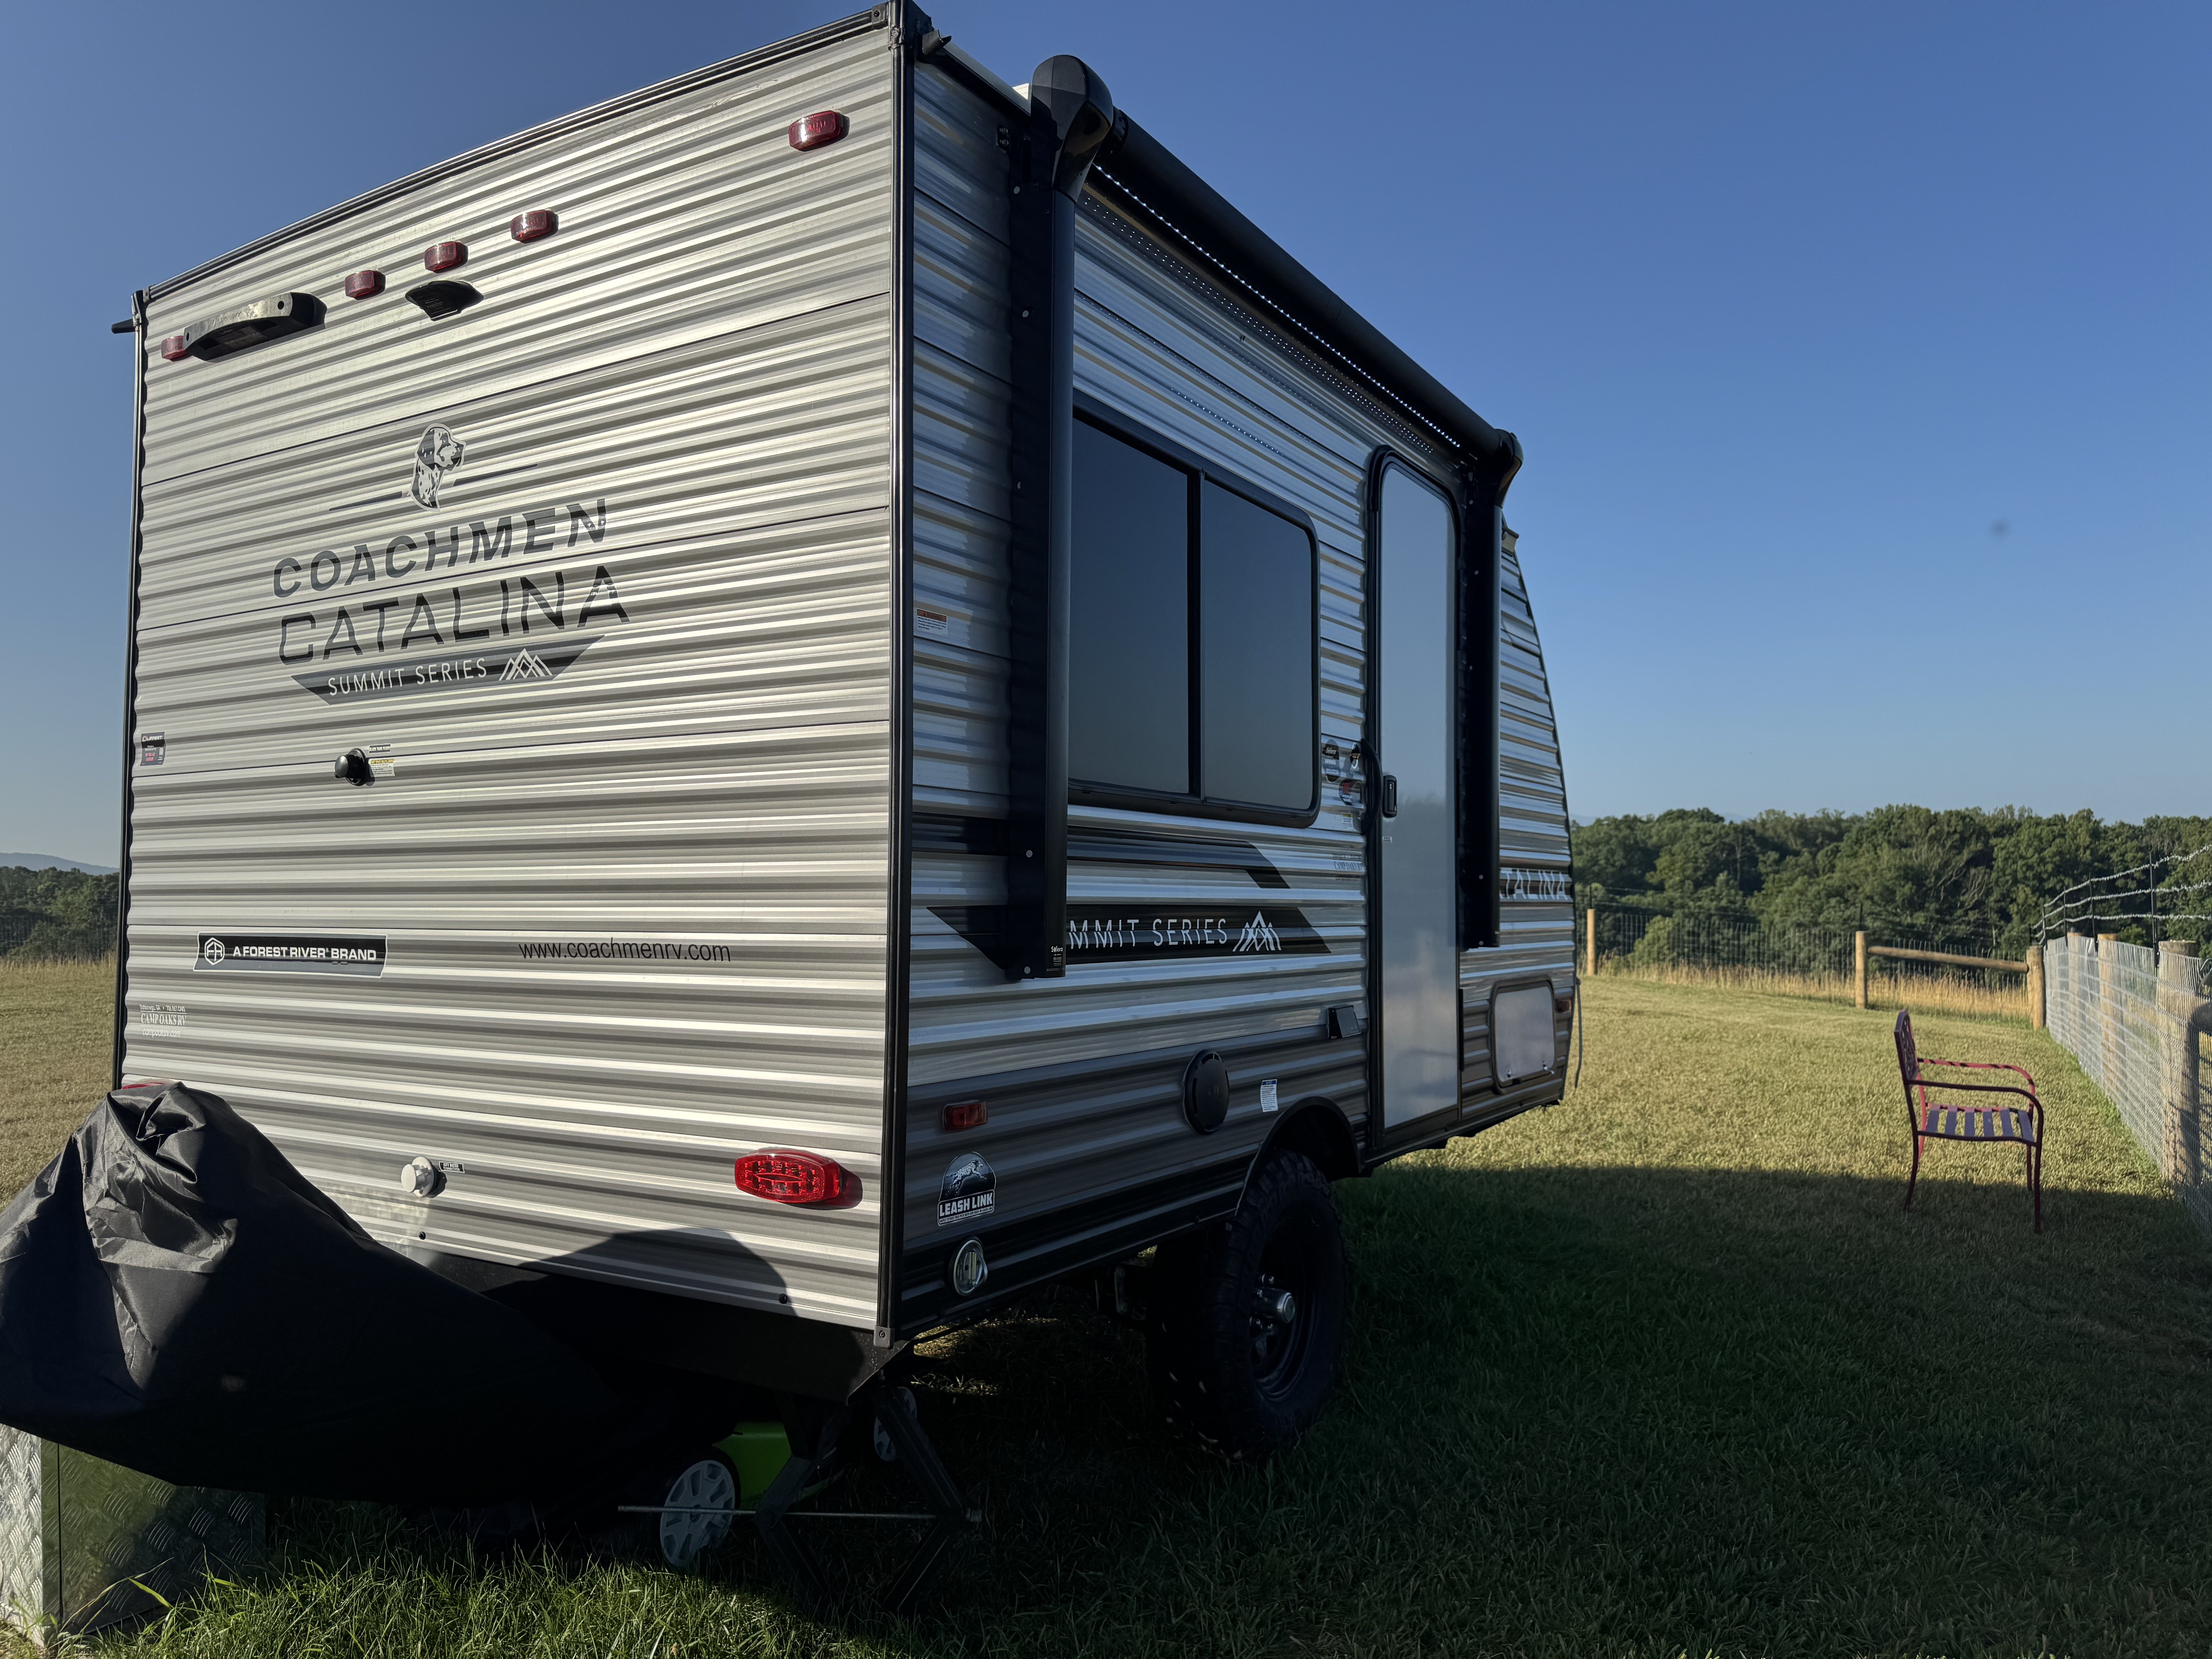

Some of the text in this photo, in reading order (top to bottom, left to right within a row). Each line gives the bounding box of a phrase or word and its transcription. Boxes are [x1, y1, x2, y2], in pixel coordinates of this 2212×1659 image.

[273, 498, 606, 598] COACHMEN
[279, 565, 630, 666] CATALINA
[328, 658, 488, 696] SUMMIT SERIES
[1500, 868, 1568, 900] TALINA
[1068, 918, 1227, 949] MMIT SERIES
[233, 946, 241, 957] A
[243, 946, 288, 957] FOREST
[290, 947, 326, 958] RIVER
[331, 948, 376, 960] BRAND
[519, 937, 731, 962] www.coachmenrv.com
[141, 1013, 187, 1025] CAMP OAKS RV
[939, 1193, 993, 1216] LEASH LINK
